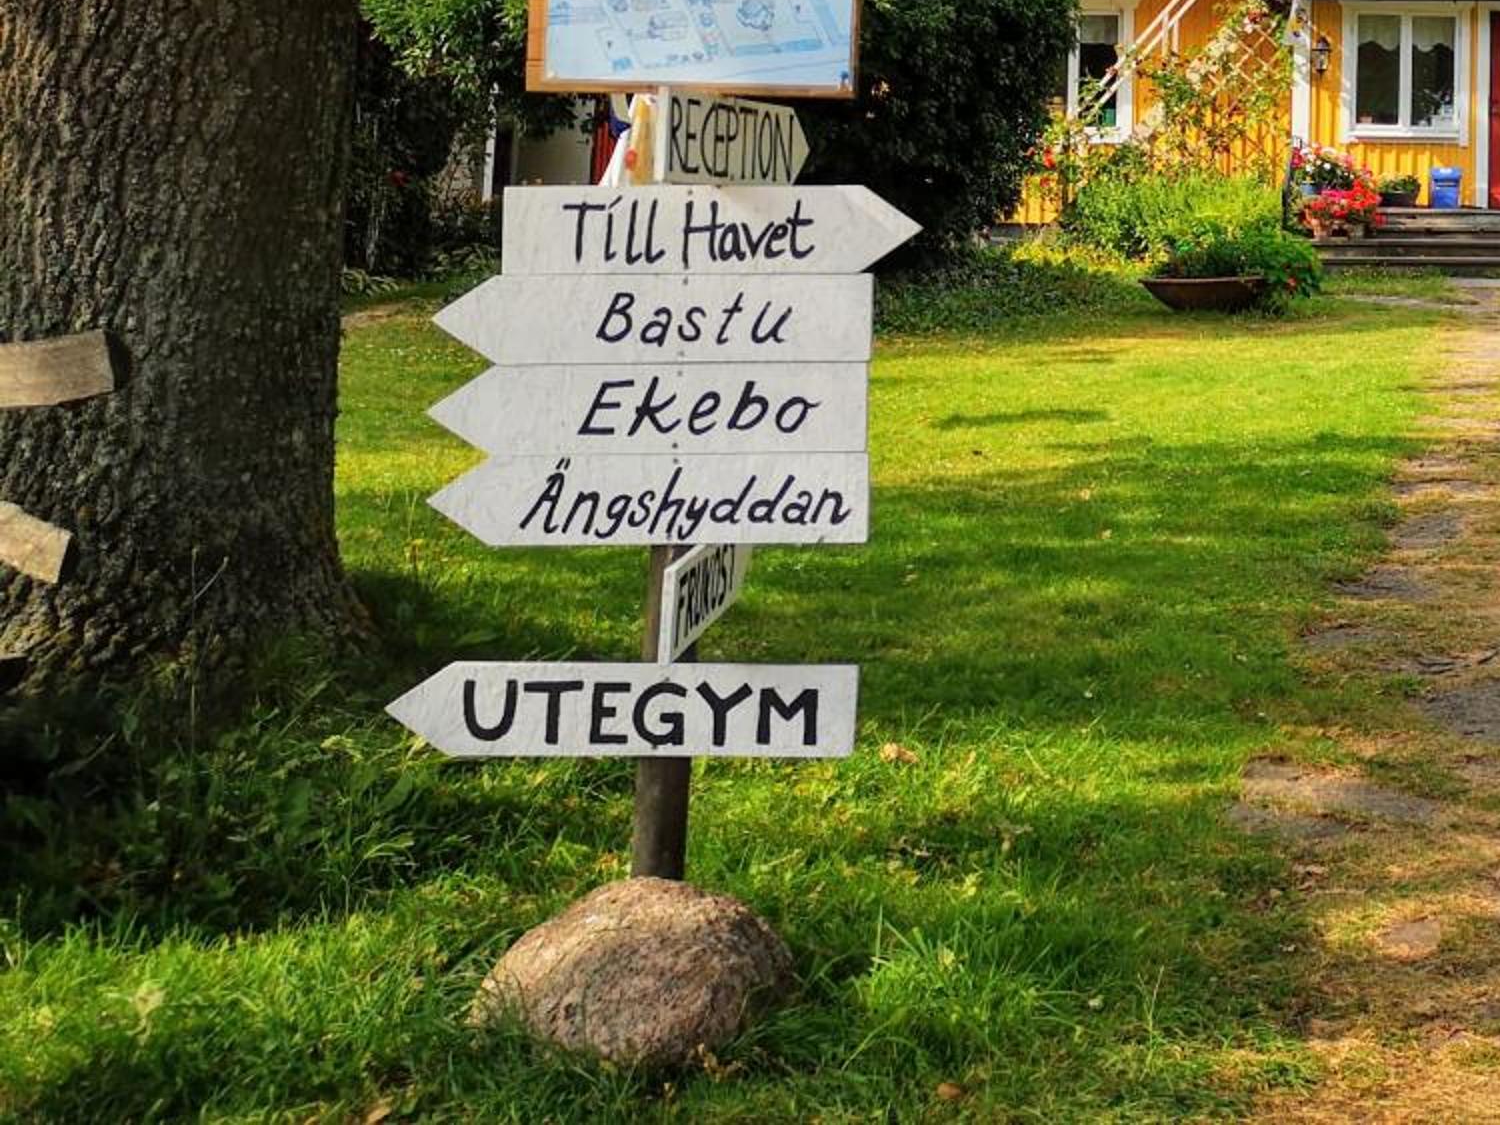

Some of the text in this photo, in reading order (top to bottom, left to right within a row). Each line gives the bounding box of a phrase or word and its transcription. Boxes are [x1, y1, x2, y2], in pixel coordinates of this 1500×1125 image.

[669, 96, 795, 183] RECEPTION
[562, 195, 815, 269] Till Havet
[596, 291, 793, 345] Bastu
[577, 376, 820, 437] Ekebo
[519, 458, 851, 541] Ängshyddan
[463, 679, 819, 747] UTEGYM
